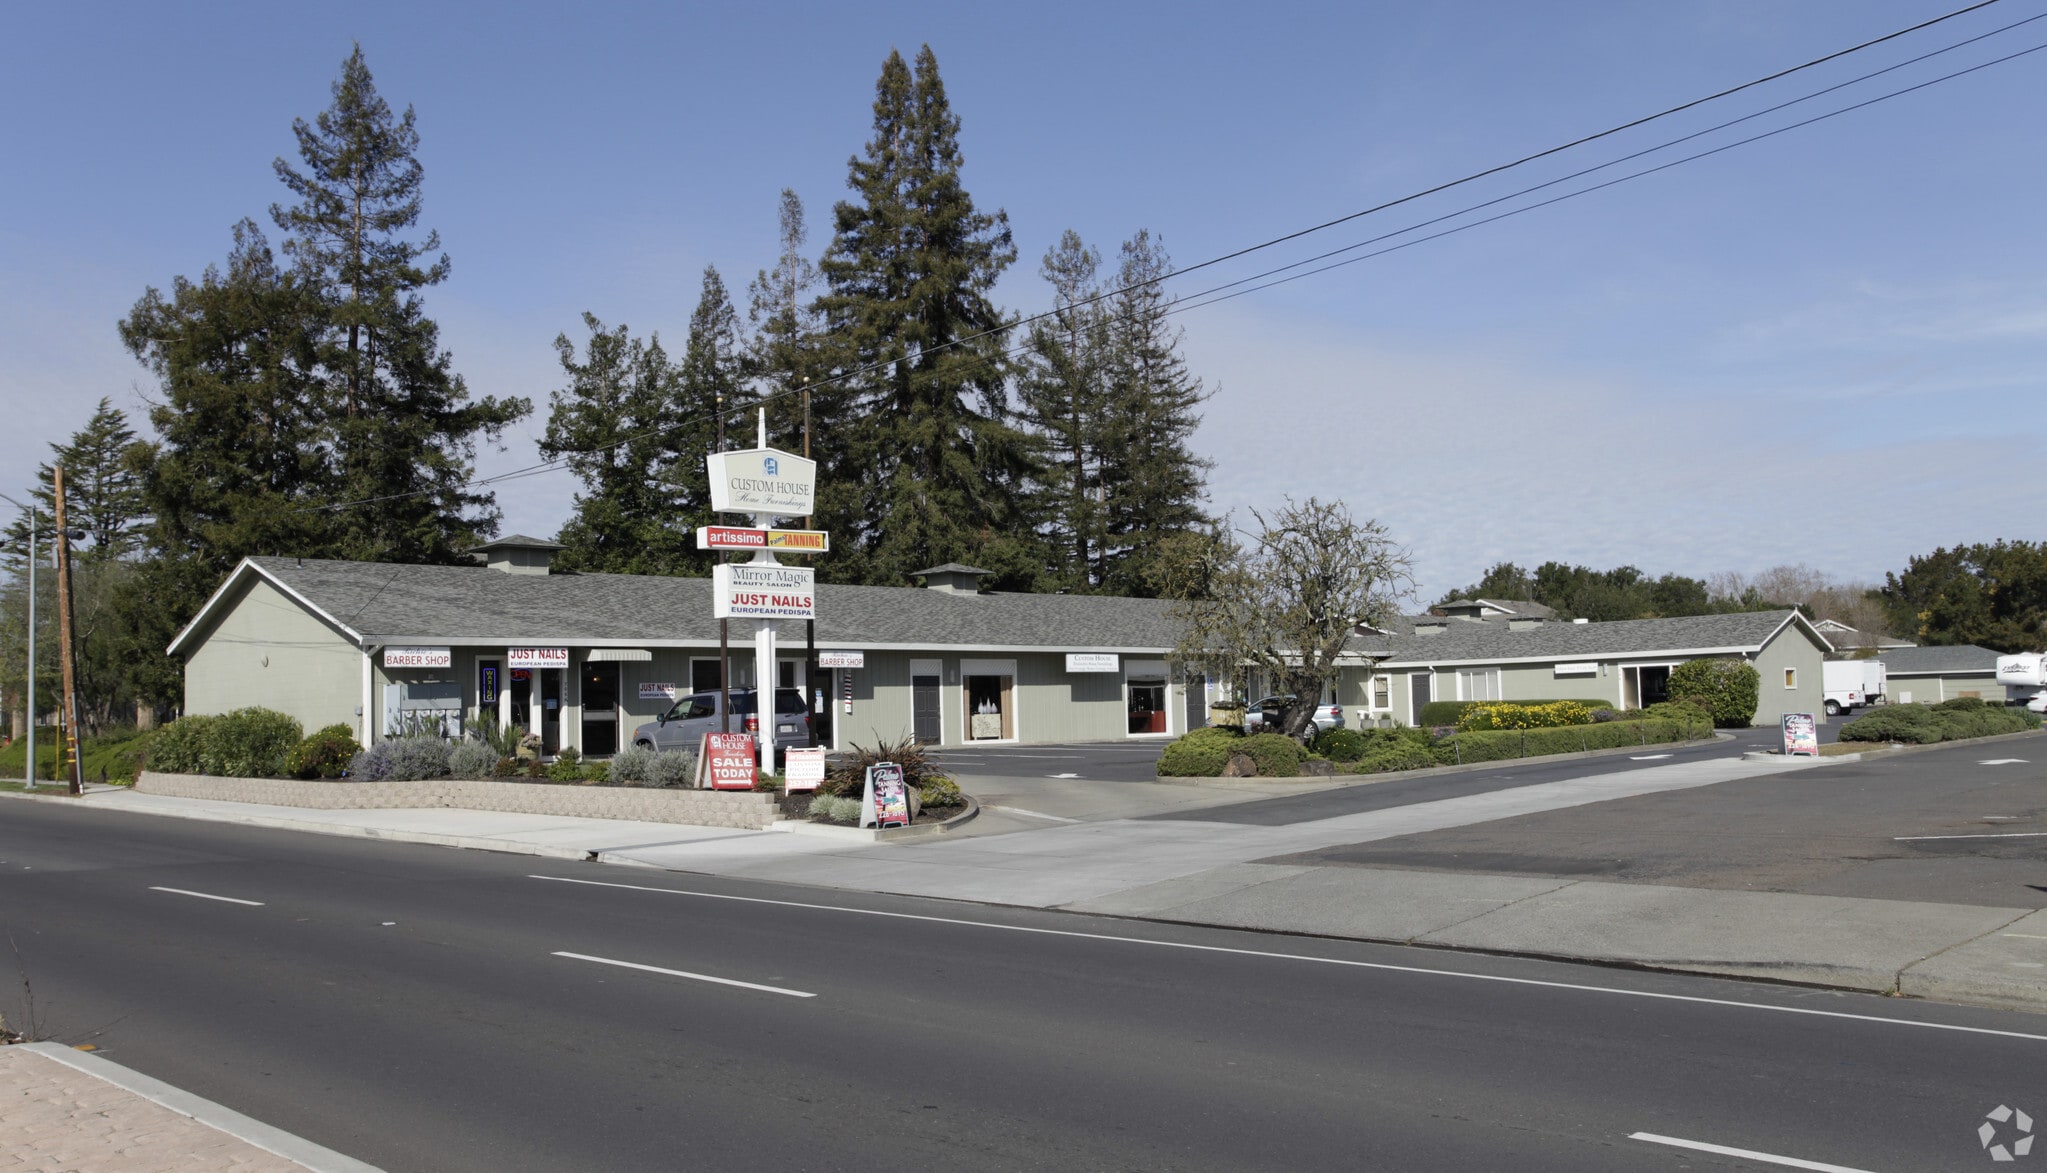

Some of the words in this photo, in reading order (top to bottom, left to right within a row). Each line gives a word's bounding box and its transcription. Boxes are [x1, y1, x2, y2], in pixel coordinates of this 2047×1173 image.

[731, 477, 774, 493] CUSTOM
[777, 482, 810, 496] HOUSE
[735, 491, 760, 502] Home
[762, 494, 807, 509] Furnishings
[710, 531, 764, 545] artissimo
[784, 533, 820, 547] TANNING
[733, 568, 773, 581] Mirror
[776, 570, 809, 588] Magic
[731, 593, 768, 606] JUST
[771, 595, 812, 608] NAILS
[731, 606, 776, 615] EUROPEAN
[778, 608, 811, 616] PEDISPA
[510, 648, 536, 660] JUST
[538, 648, 567, 660] NAILS
[386, 655, 423, 665] BARBER
[425, 655, 450, 665] SHOP
[820, 657, 845, 666] BARBER
[846, 658, 863, 666] SHOP
[485, 670, 494, 700] WAXING
[640, 683, 656, 691] JUST
[657, 683, 675, 691] NAILS
[721, 733, 752, 742] CUSTOM
[722, 742, 746, 750] HOUSE
[712, 757, 753, 767] SALE
[713, 768, 753, 778] TODAY
